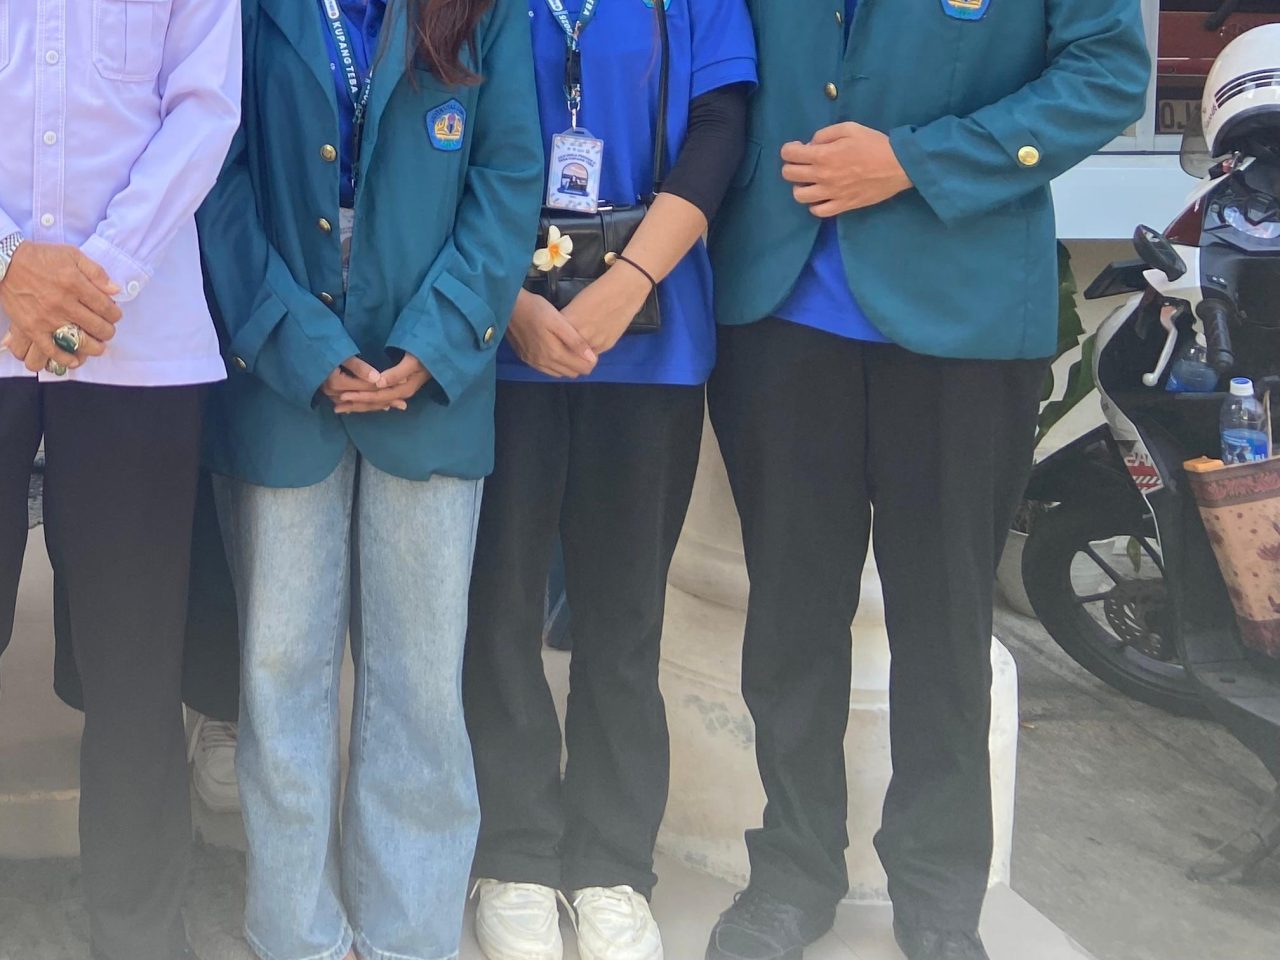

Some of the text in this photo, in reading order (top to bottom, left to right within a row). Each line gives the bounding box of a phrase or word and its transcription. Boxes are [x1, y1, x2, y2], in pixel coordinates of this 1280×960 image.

[559, 15, 573, 36] 2025
[332, 21, 358, 94] KUPANG TEBA
